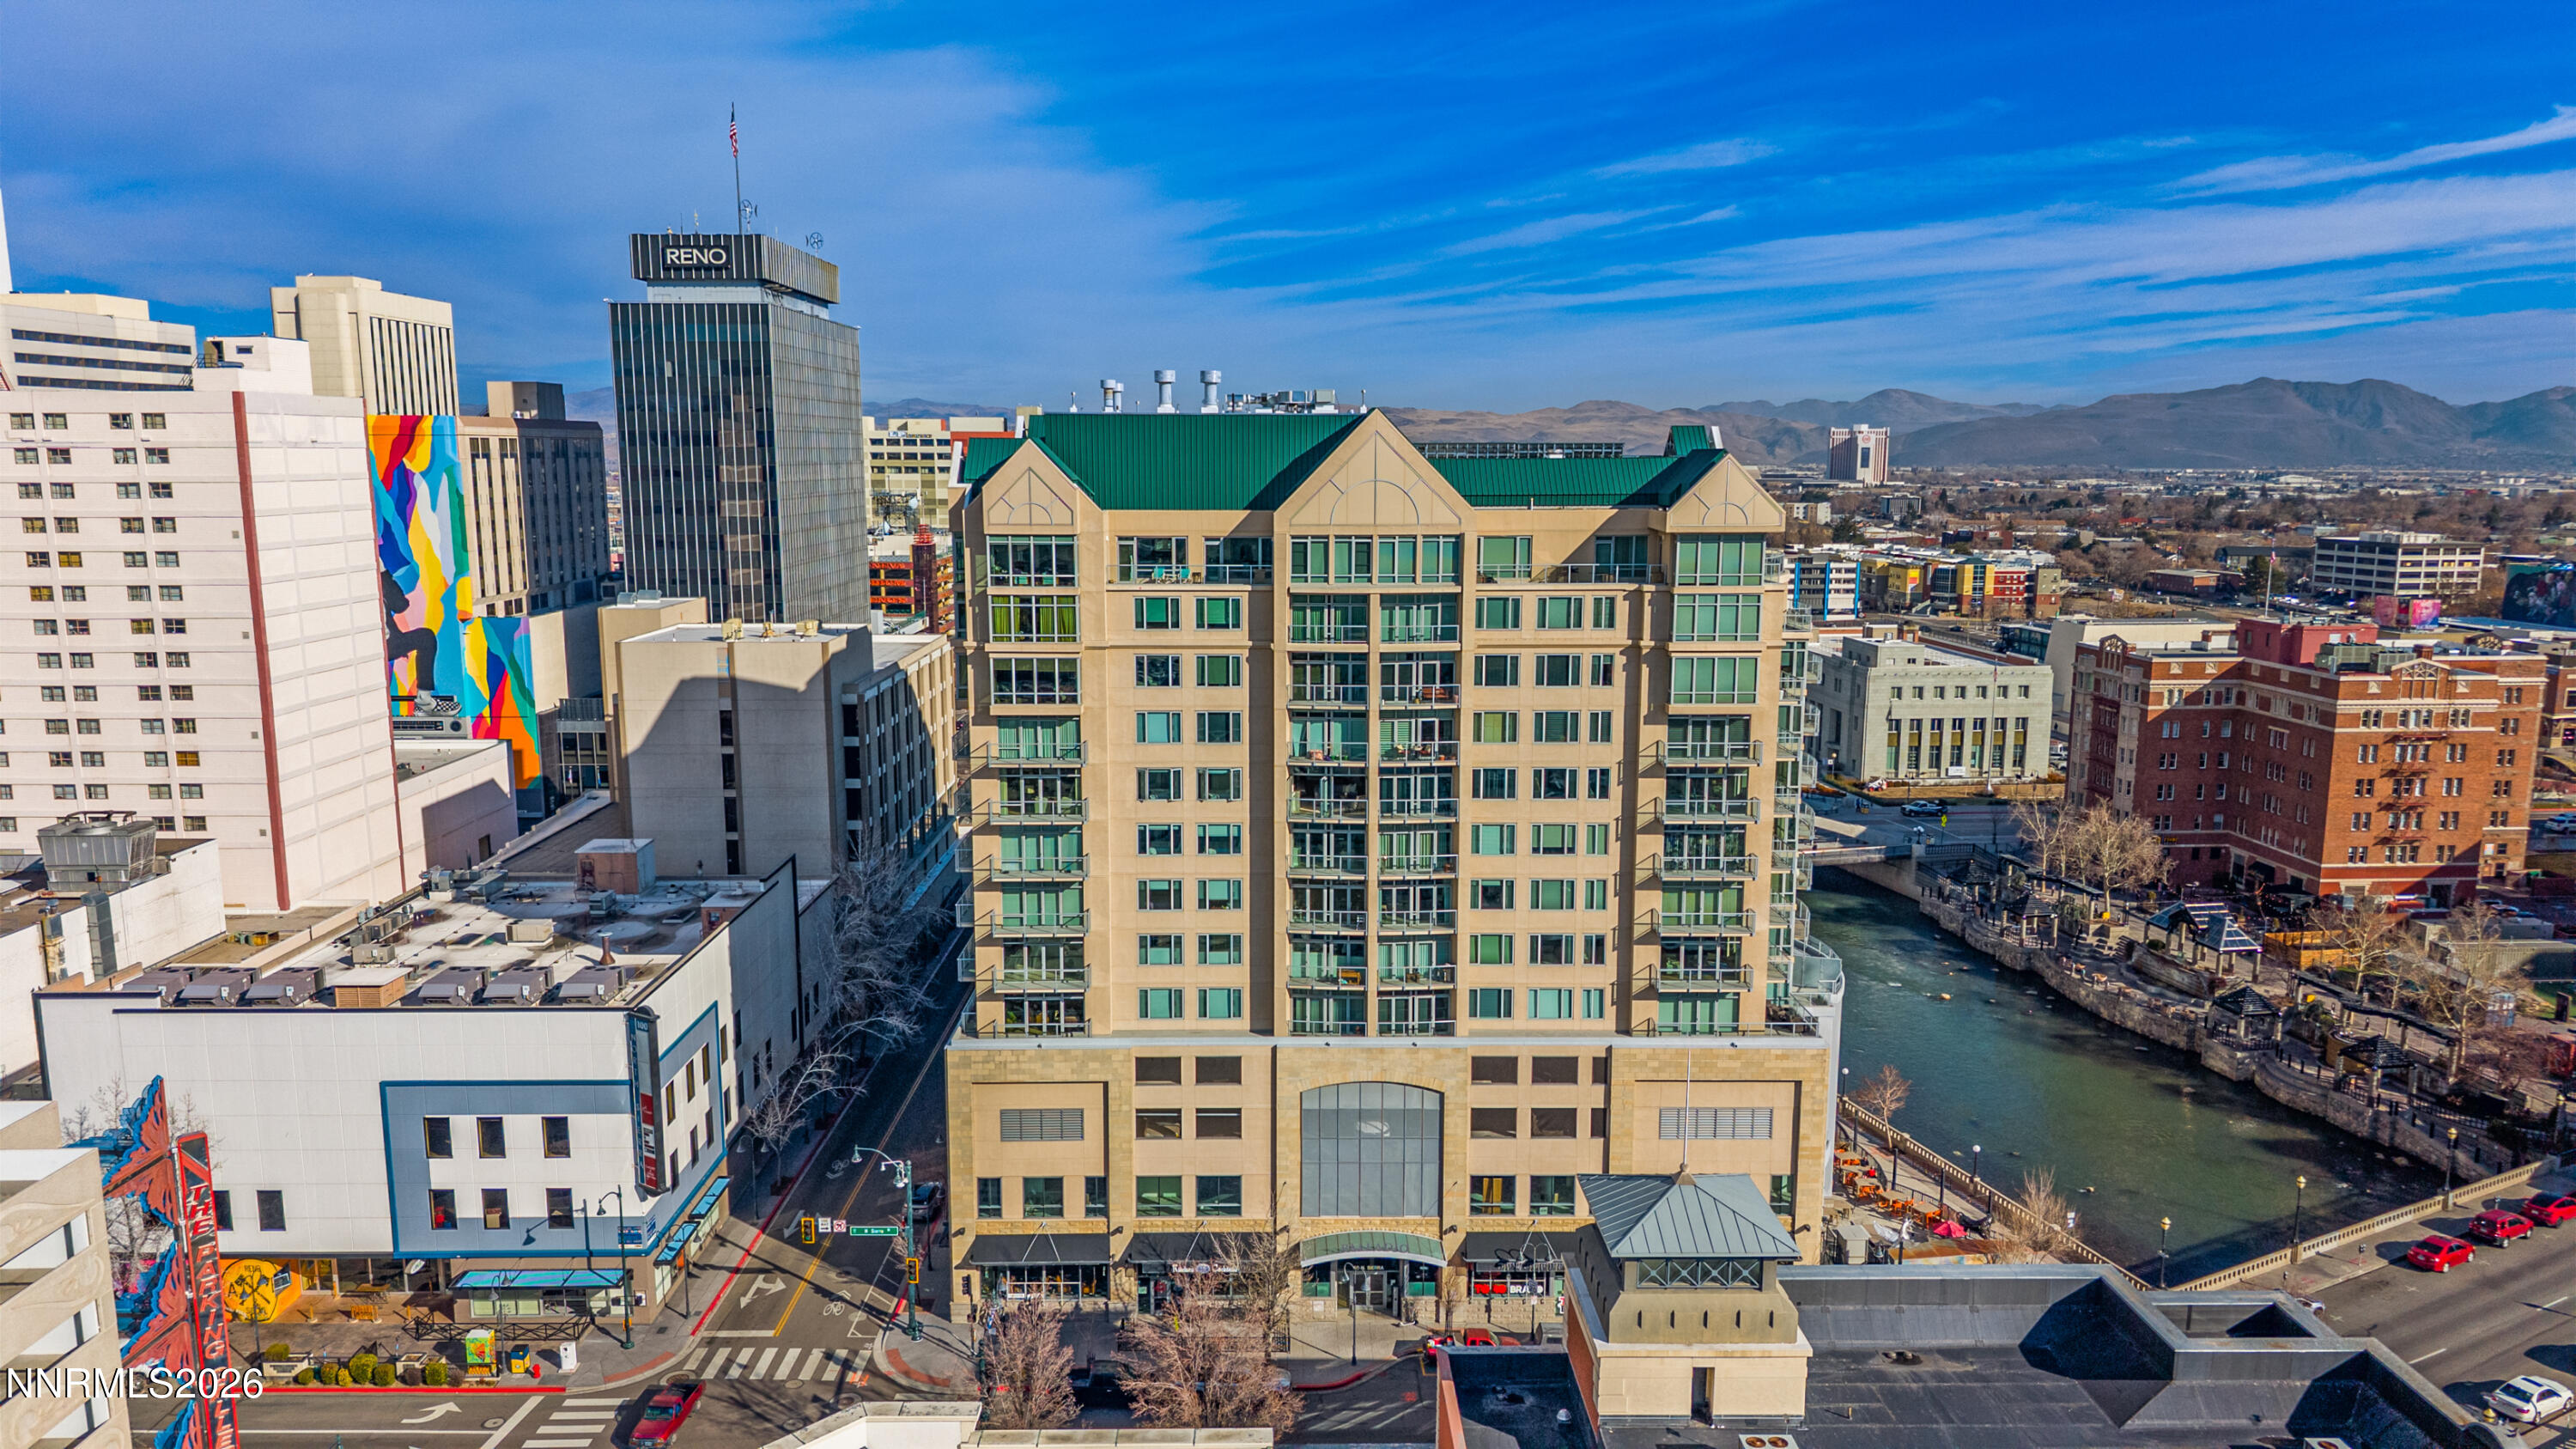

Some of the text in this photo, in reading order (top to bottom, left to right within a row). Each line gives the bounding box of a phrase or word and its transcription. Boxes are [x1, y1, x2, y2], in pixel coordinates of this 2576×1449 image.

[666, 248, 726, 265] RENO
[637, 1020, 648, 1031] 100
[187, 1182, 212, 1238] THE
[1510, 1285, 1544, 1294] BRAD
[196, 1245, 225, 1360] PARKING
